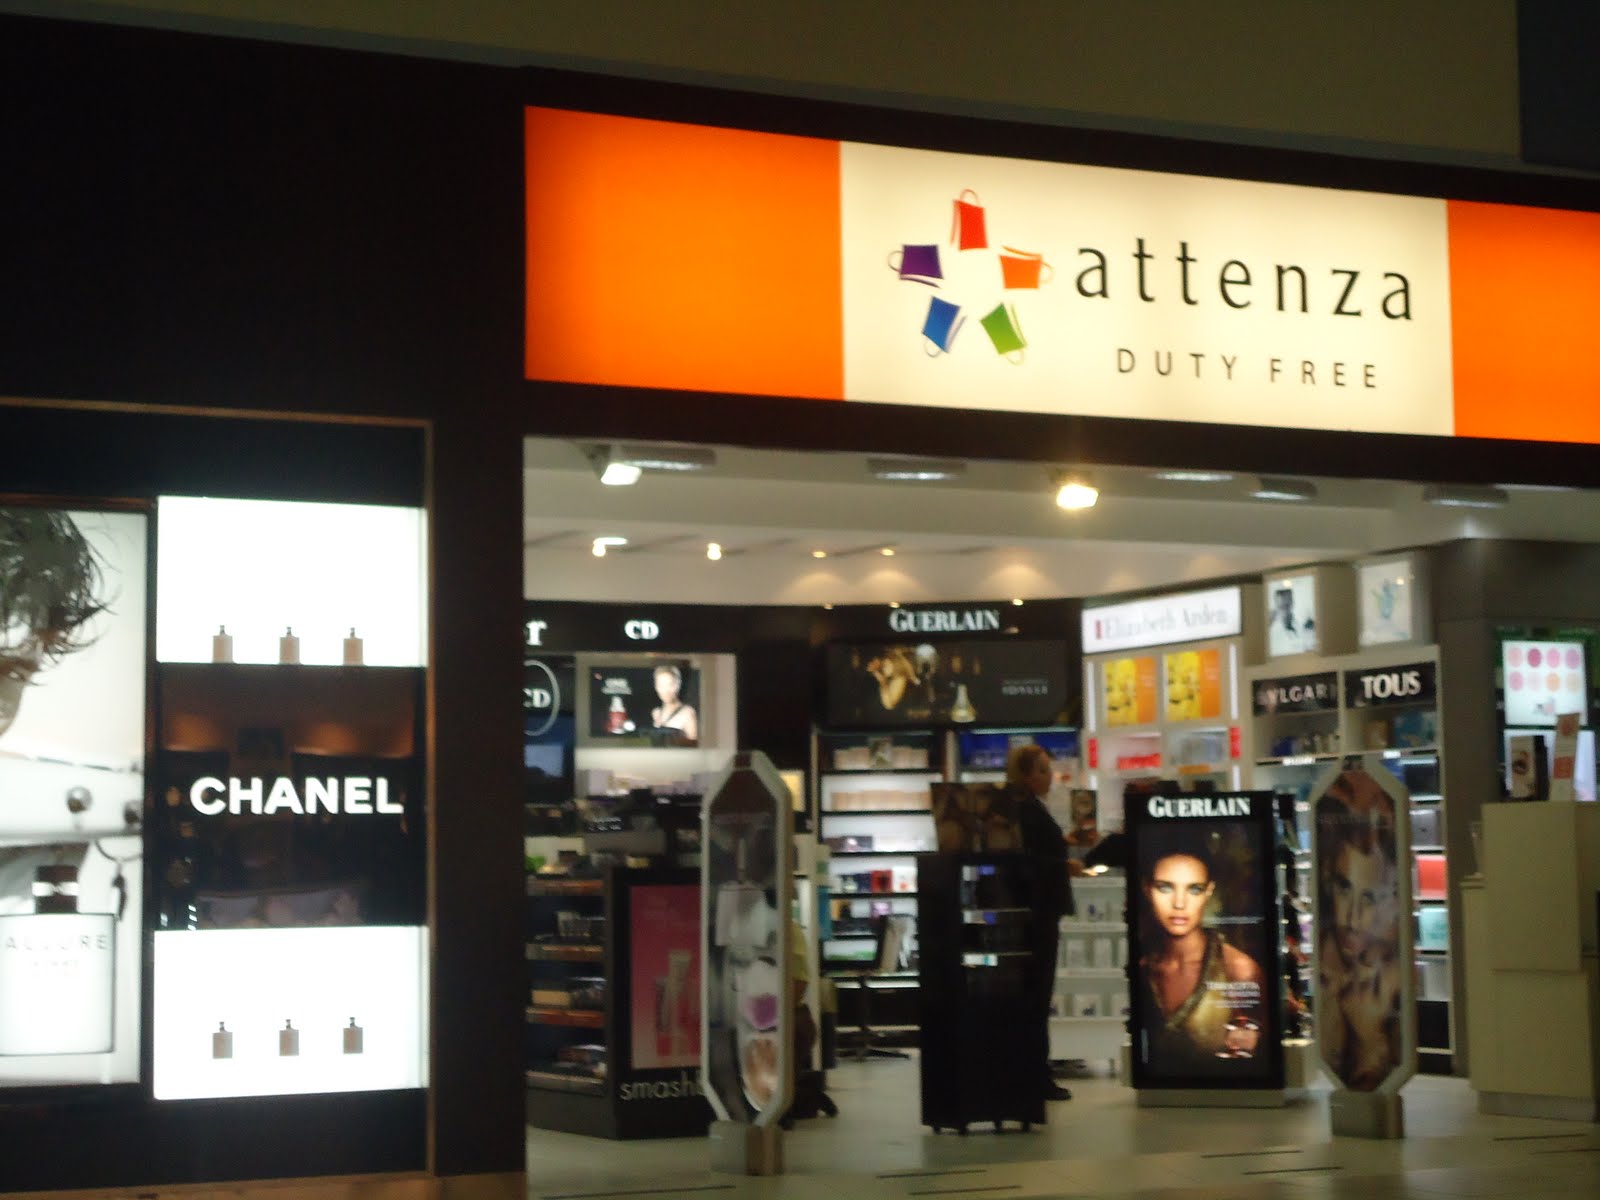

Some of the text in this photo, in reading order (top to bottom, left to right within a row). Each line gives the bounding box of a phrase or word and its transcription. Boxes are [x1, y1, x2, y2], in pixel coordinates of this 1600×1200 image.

[1075, 238, 1413, 320] attenza
[1116, 348, 1377, 388] DUTY FREE
[624, 619, 659, 640] CD
[889, 608, 1000, 633] GUERLAIN
[1360, 670, 1422, 700] TOUS
[189, 776, 404, 816] CHANEL
[1147, 795, 1251, 818] GUERLAIN
